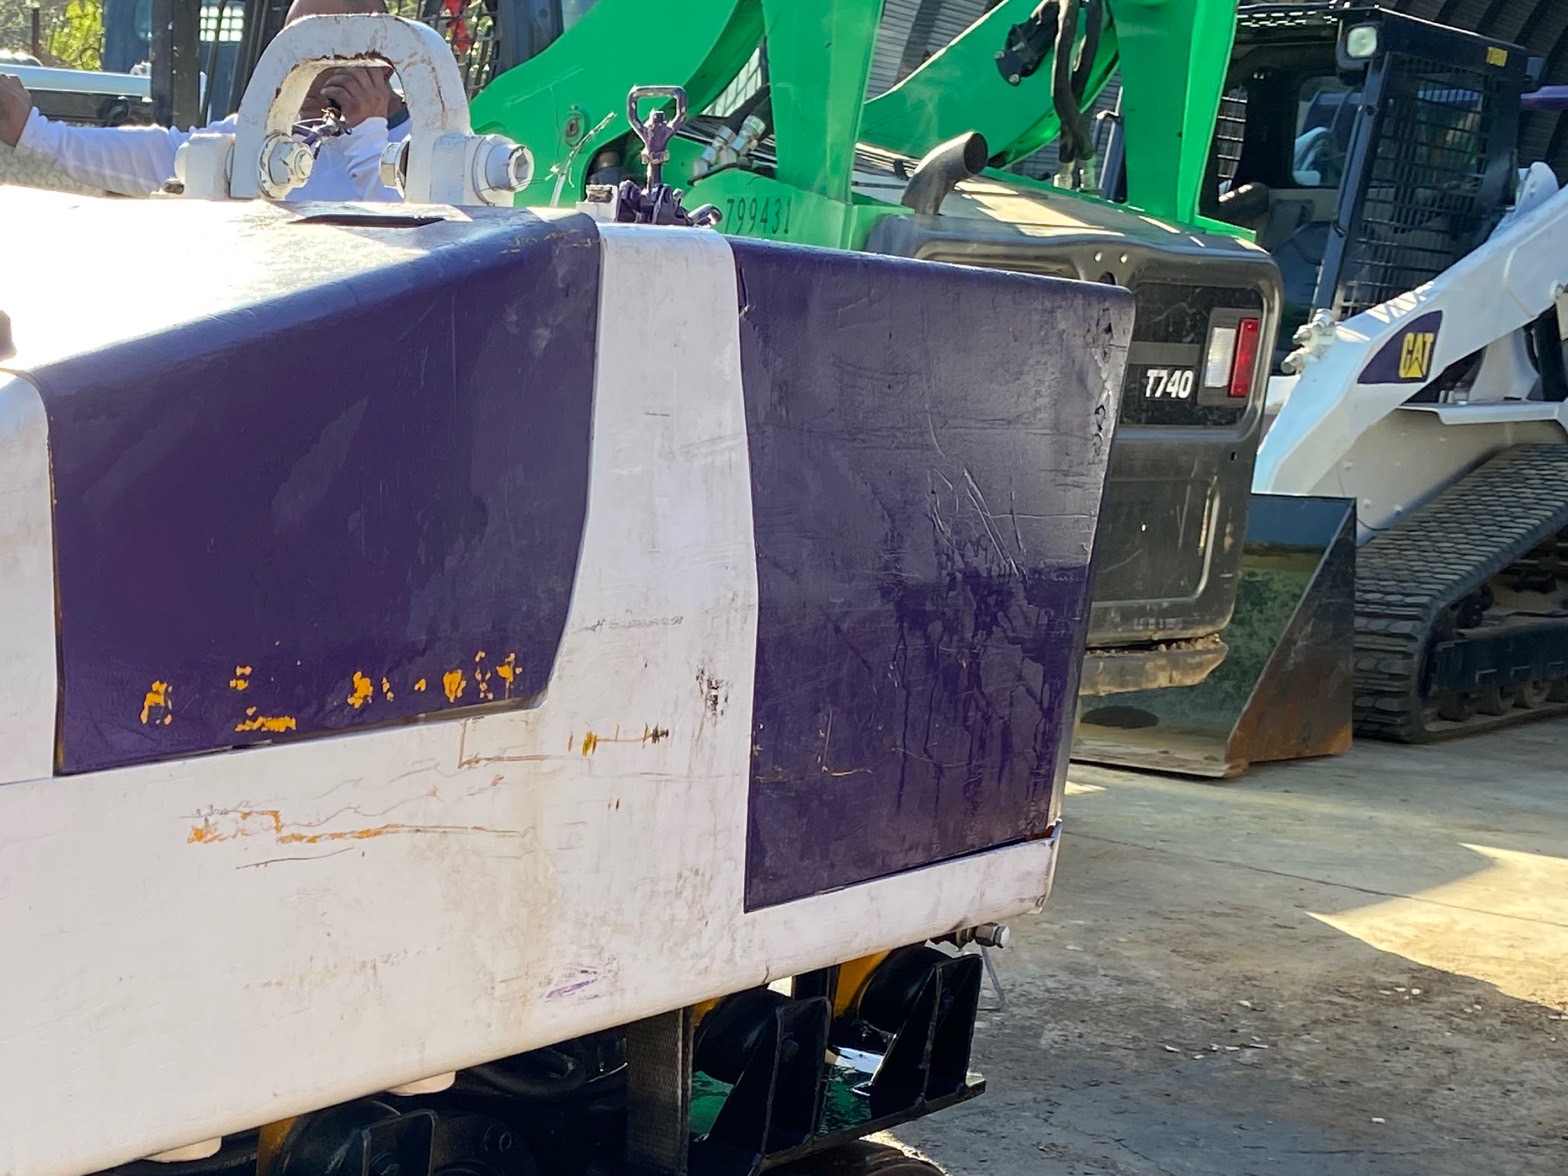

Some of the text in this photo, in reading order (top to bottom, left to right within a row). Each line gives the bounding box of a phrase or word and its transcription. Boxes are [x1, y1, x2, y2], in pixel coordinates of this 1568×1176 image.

[725, 197, 792, 235] 799431
[1399, 332, 1434, 378] CAT
[1146, 369, 1193, 398] T740
